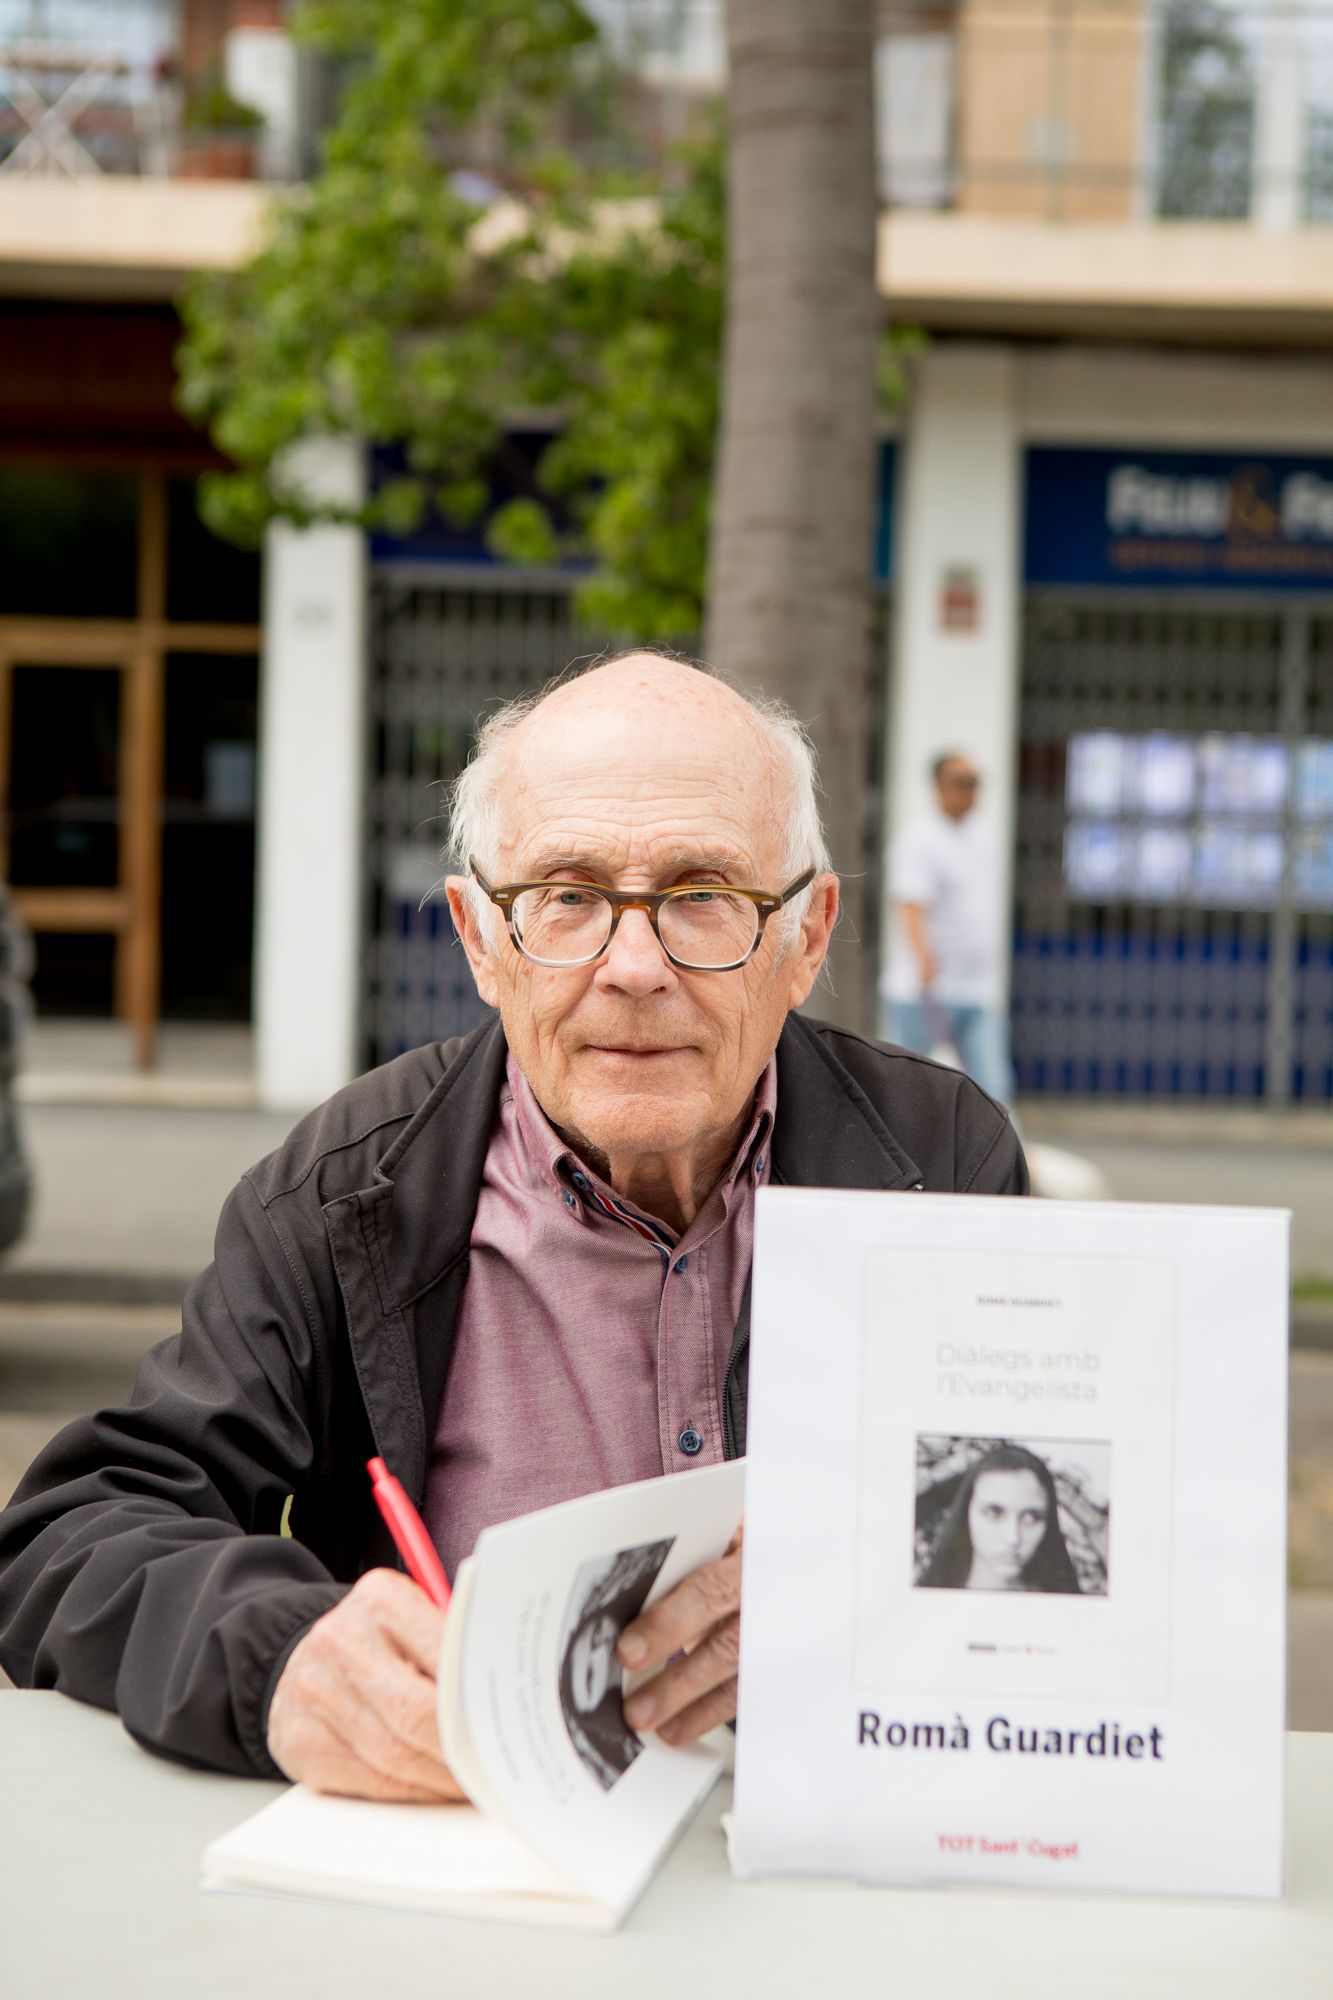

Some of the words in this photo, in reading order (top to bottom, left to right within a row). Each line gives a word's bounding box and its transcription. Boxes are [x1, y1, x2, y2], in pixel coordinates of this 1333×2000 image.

[937, 1342, 1032, 1371] Diàlegs
[1040, 1349, 1101, 1371] amb
[858, 1711, 970, 1749] Romà
[986, 1716, 1164, 1760] Guardiet
[937, 1833, 975, 1854] TOT
[979, 1835, 1018, 1855] Sant
